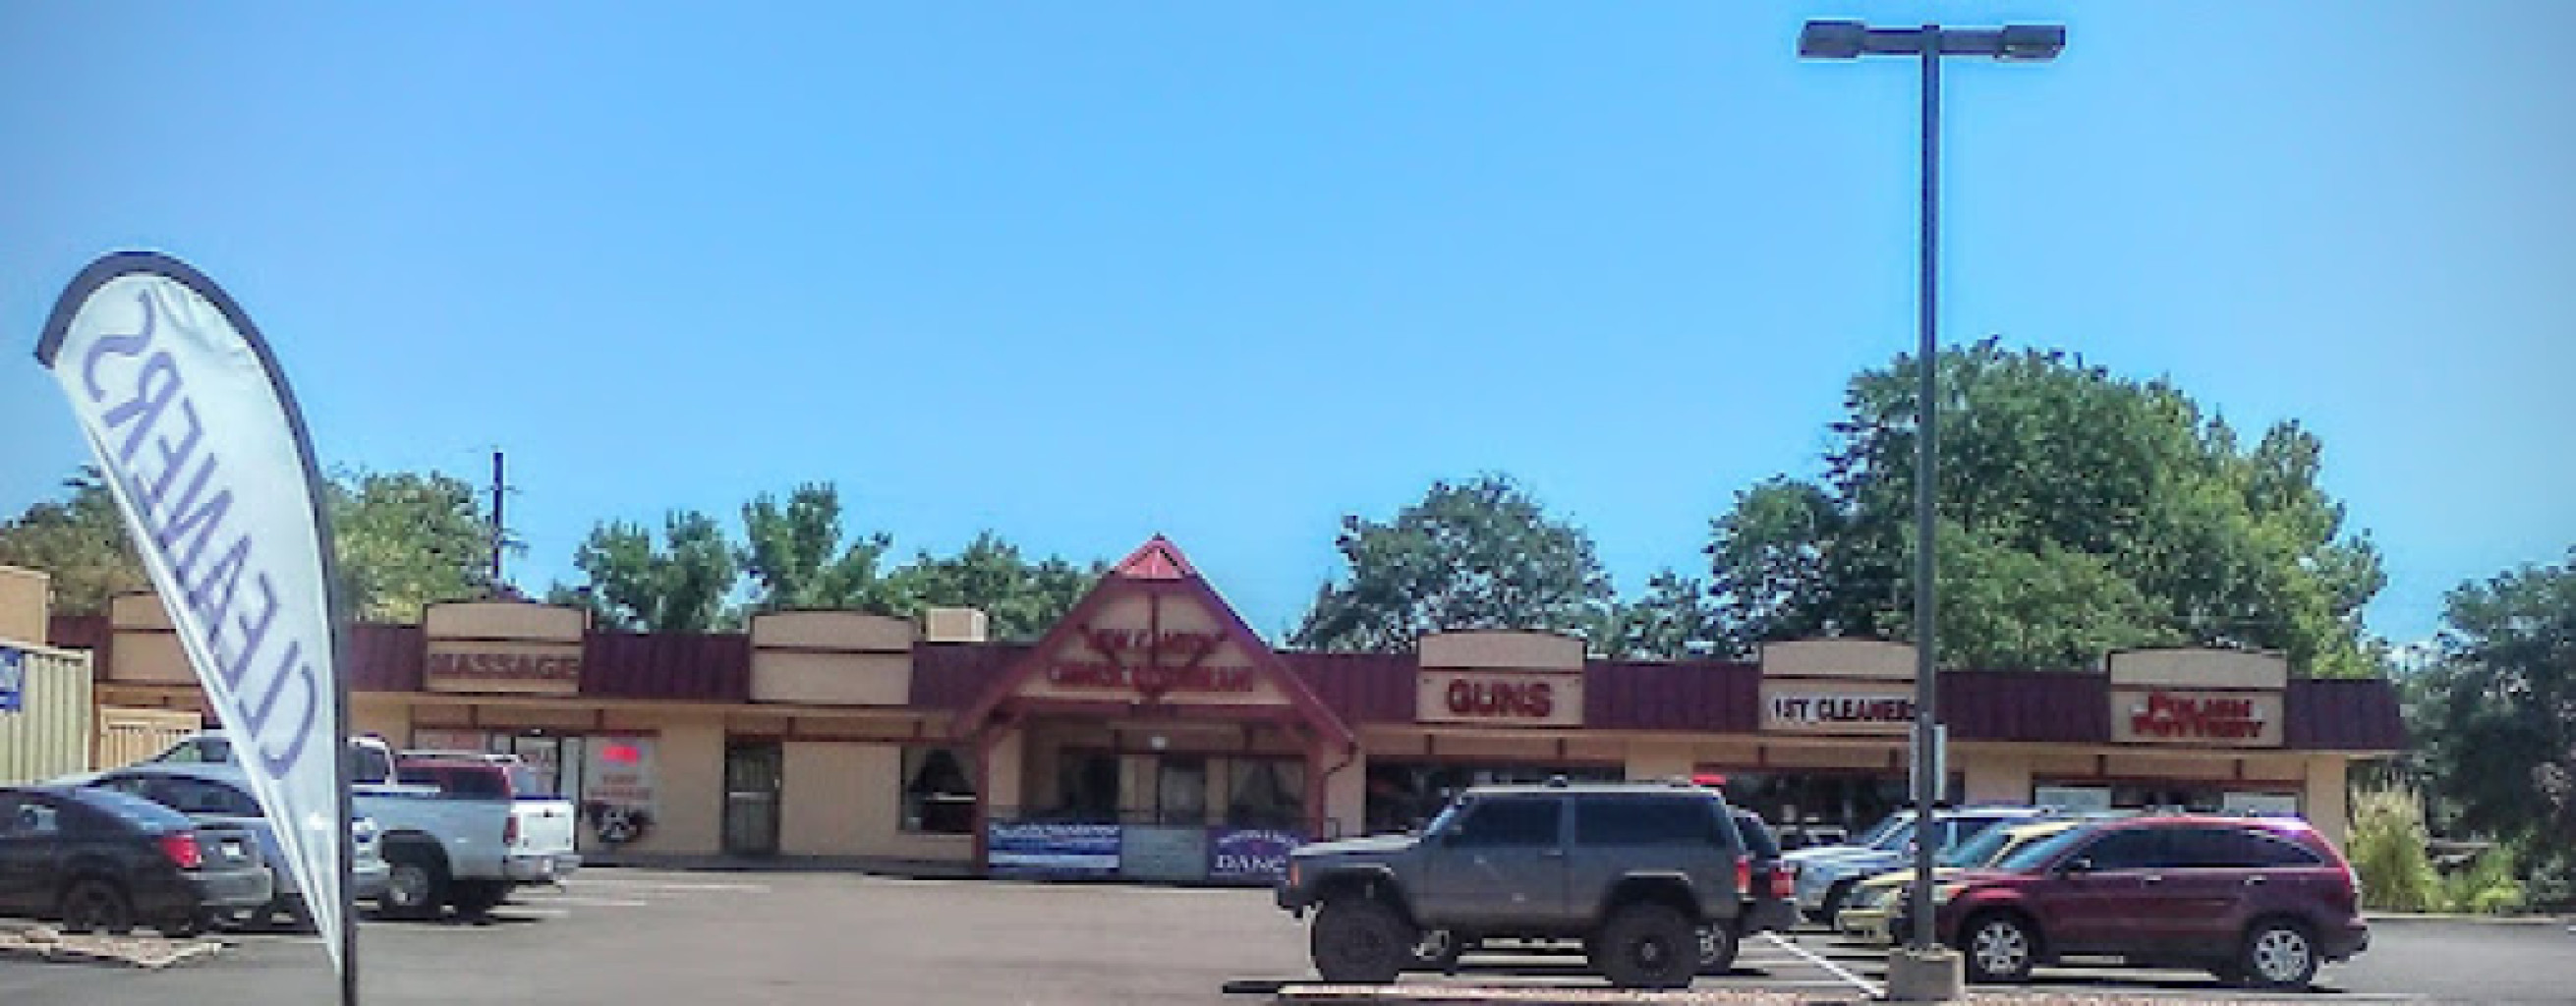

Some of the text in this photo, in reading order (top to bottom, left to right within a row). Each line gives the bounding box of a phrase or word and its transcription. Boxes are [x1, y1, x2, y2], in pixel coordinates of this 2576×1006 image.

[431, 652, 580, 680] MASSAGE
[1447, 678, 1553, 717] GUNS
[1775, 698, 1809, 722] 1ST
[2147, 690, 2255, 721] POLISH
[2132, 715, 2265, 739] POTTERY
[1215, 855, 1287, 872] DANC
